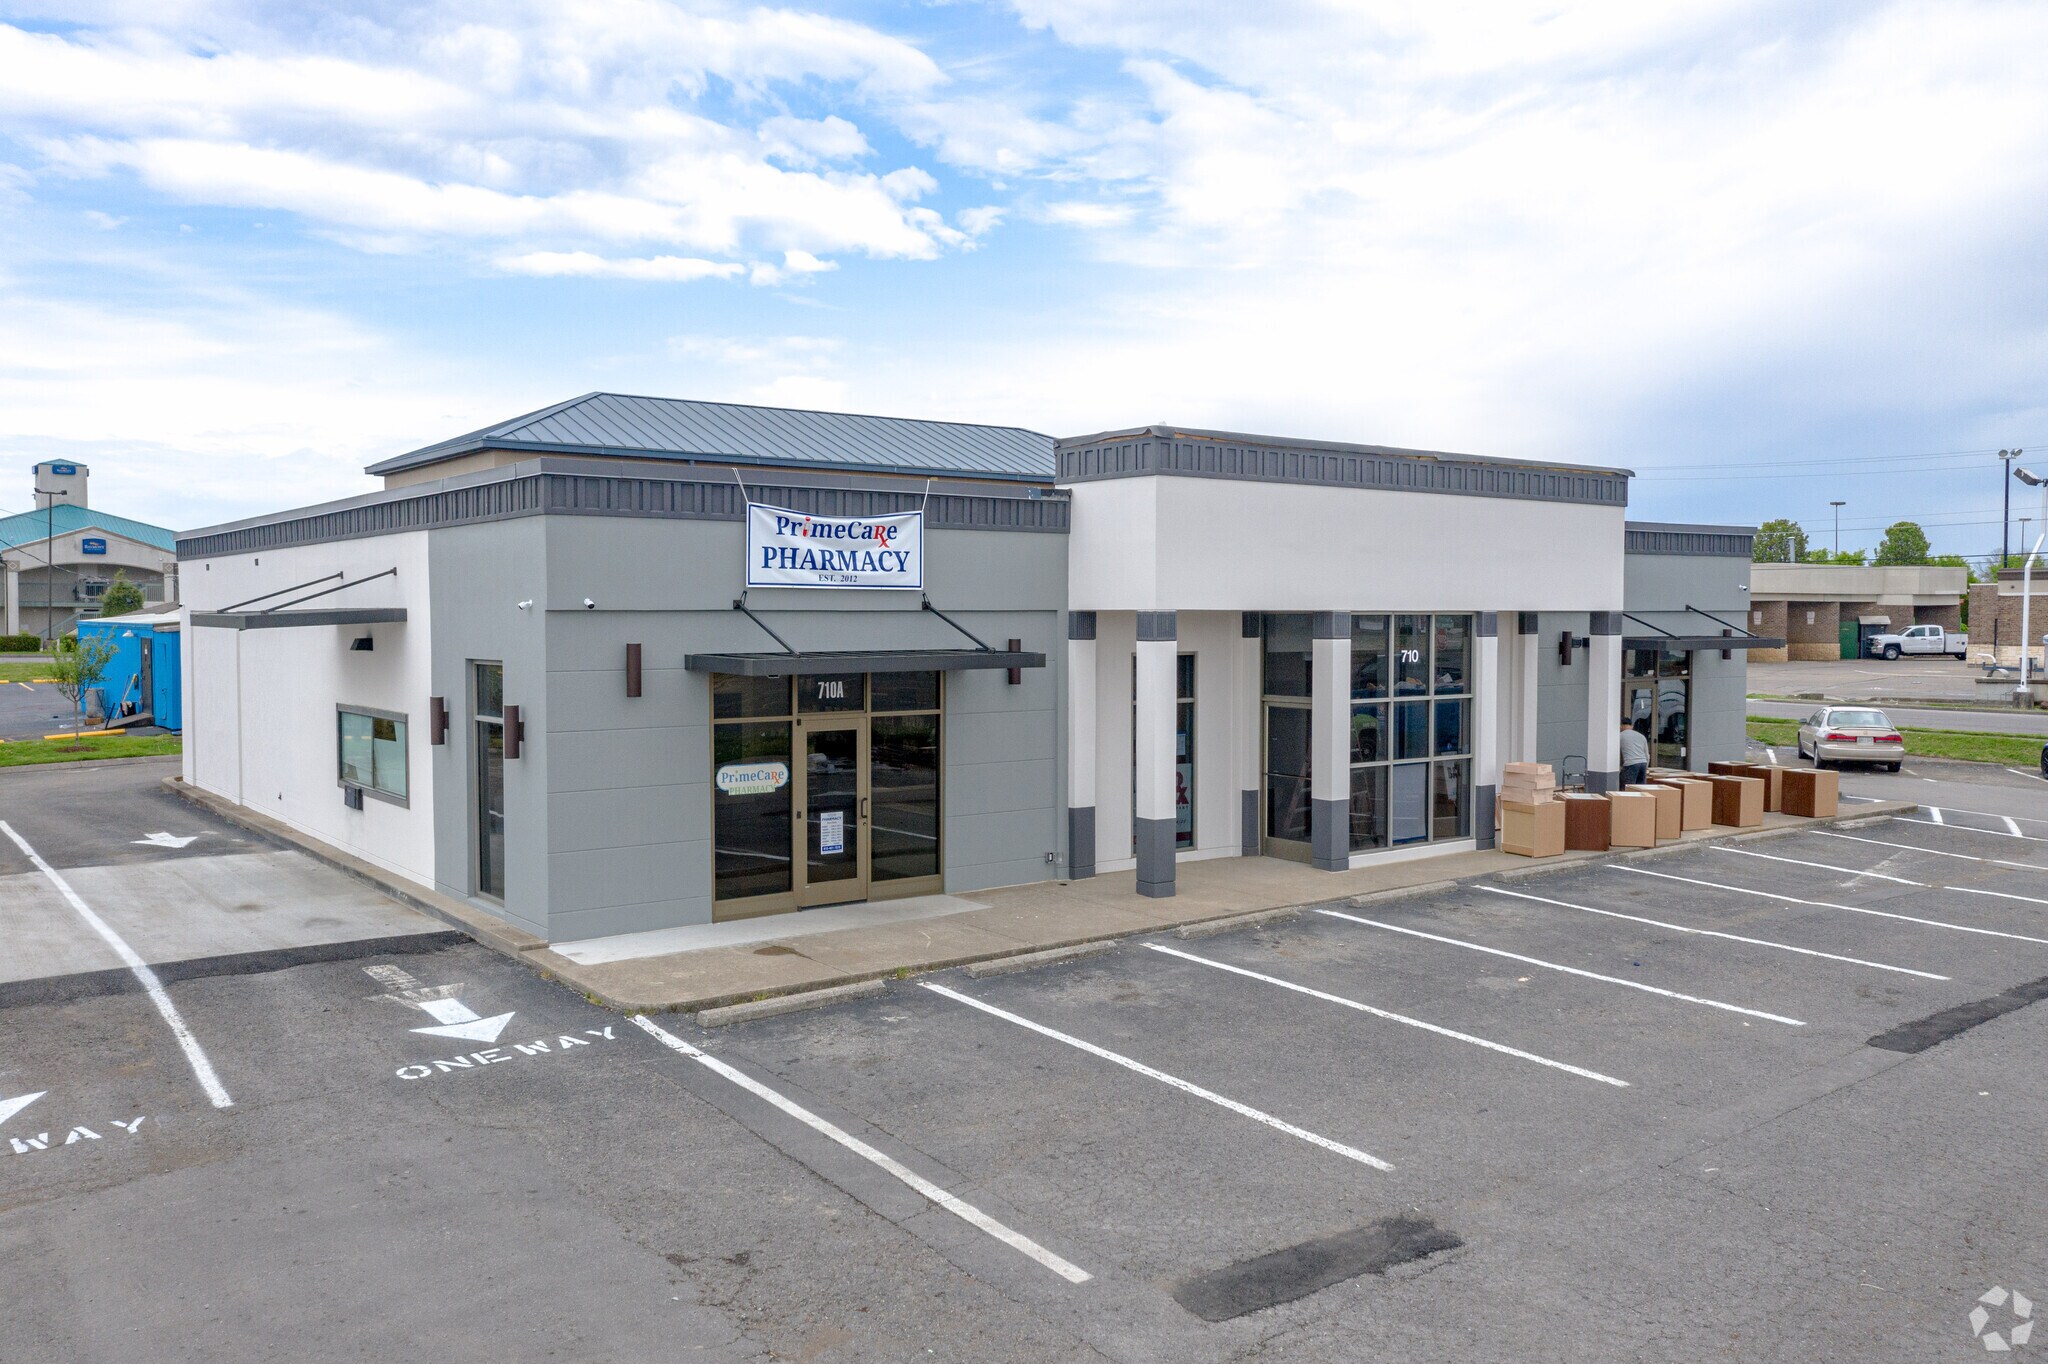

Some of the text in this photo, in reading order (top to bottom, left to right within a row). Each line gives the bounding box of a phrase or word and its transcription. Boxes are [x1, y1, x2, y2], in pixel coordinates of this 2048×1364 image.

[761, 546, 910, 572] PHARMACY
[818, 574, 858, 583] EST. 2012
[1401, 650, 1419, 663] 710
[817, 681, 844, 699] 710A
[730, 784, 775, 794] PHARMACY
[396, 1026, 616, 1080] ONE WAY
[9, 1116, 146, 1154] WAY
